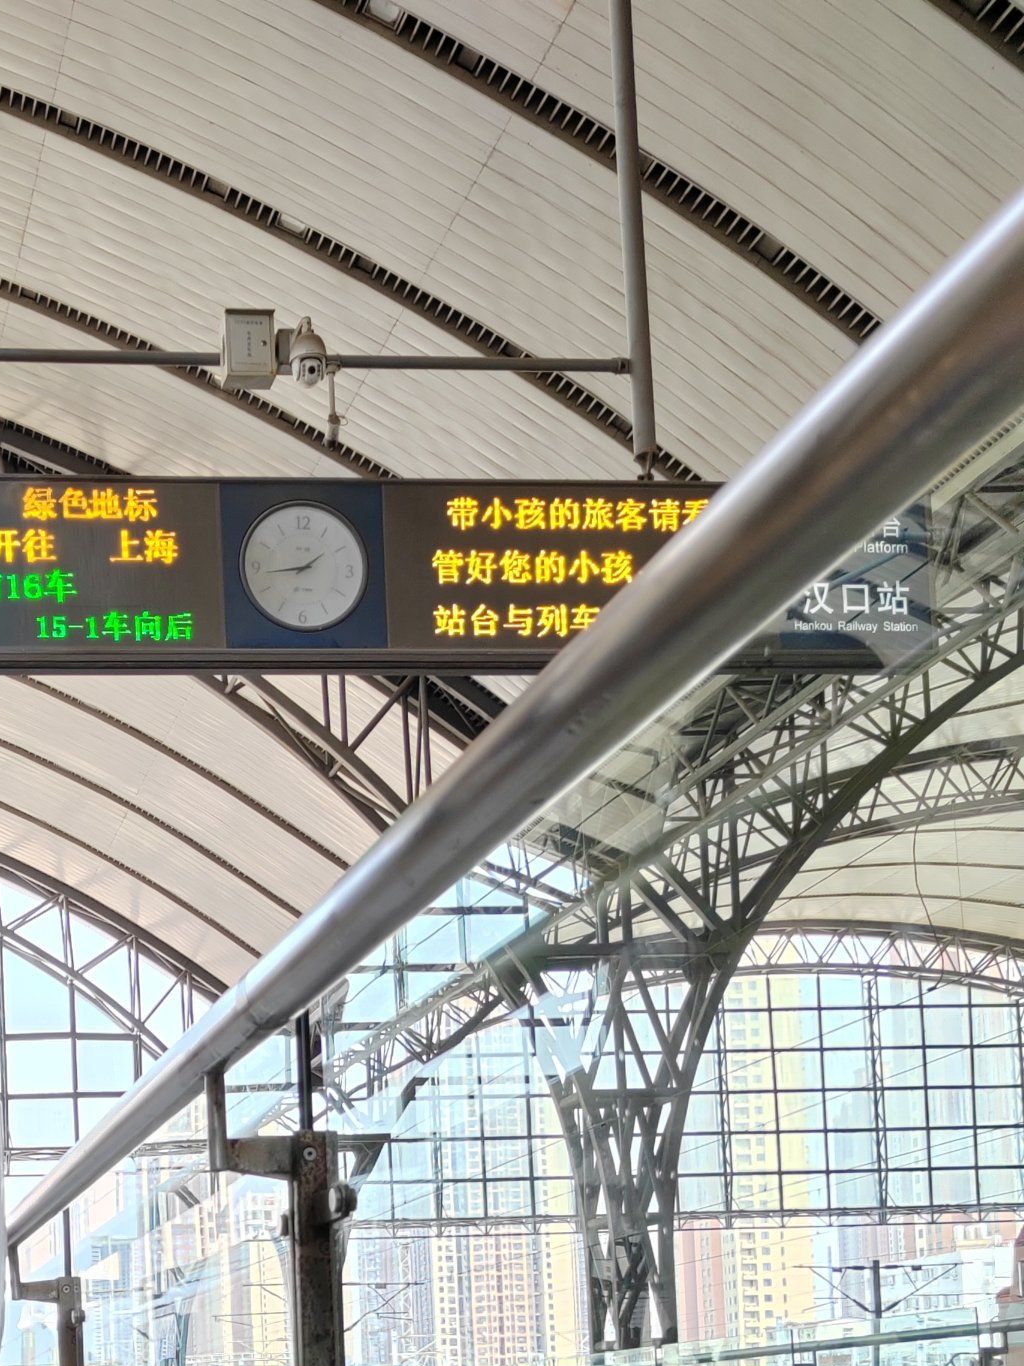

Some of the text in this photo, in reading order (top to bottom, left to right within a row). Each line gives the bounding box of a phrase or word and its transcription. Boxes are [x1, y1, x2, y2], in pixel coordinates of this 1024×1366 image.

[22, 487, 158, 521] 绿色地标
[295, 516, 312, 530] 12
[109, 529, 178, 564] 上海
[432, 549, 633, 584] 管好您的小孩
[802, 580, 910, 615] 汉口站
[36, 611, 192, 642] 15-1车向后
[433, 603, 601, 638] 站台与列车
[794, 620, 919, 633] Hankou Railway Station
